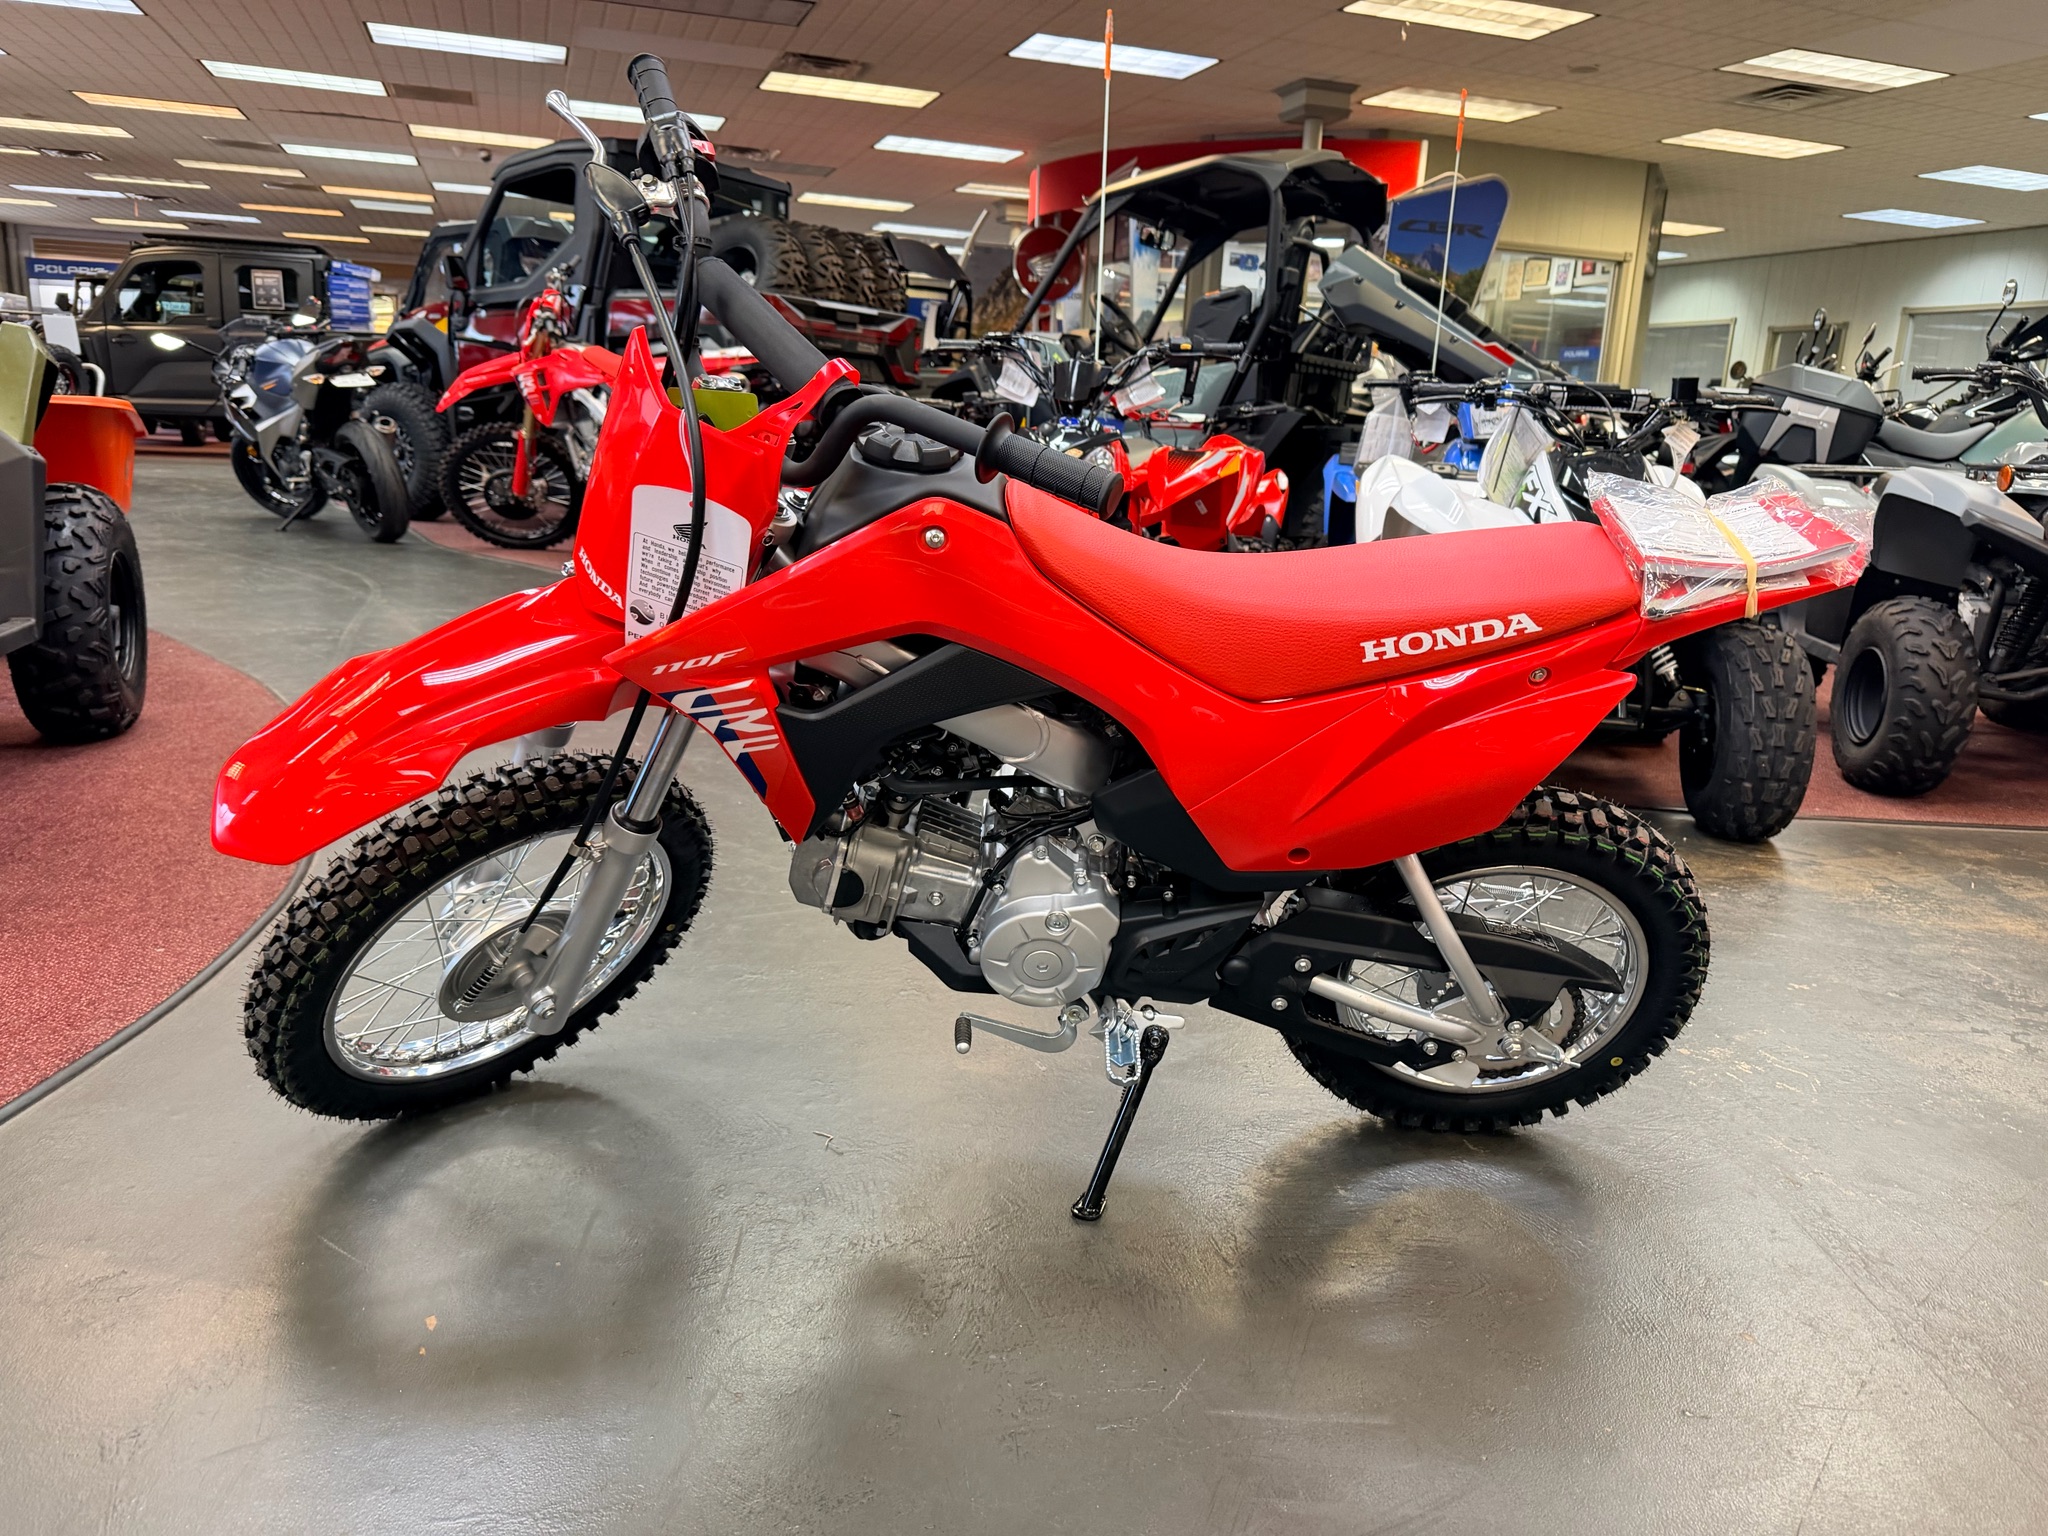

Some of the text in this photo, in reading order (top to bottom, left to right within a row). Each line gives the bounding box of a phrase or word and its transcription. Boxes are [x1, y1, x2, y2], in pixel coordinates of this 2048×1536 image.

[578, 546, 624, 610] HONDA
[706, 560, 735, 574] performance
[652, 646, 747, 676] 110F
[1360, 612, 1543, 663] HONDA
[671, 679, 780, 762] CRF
